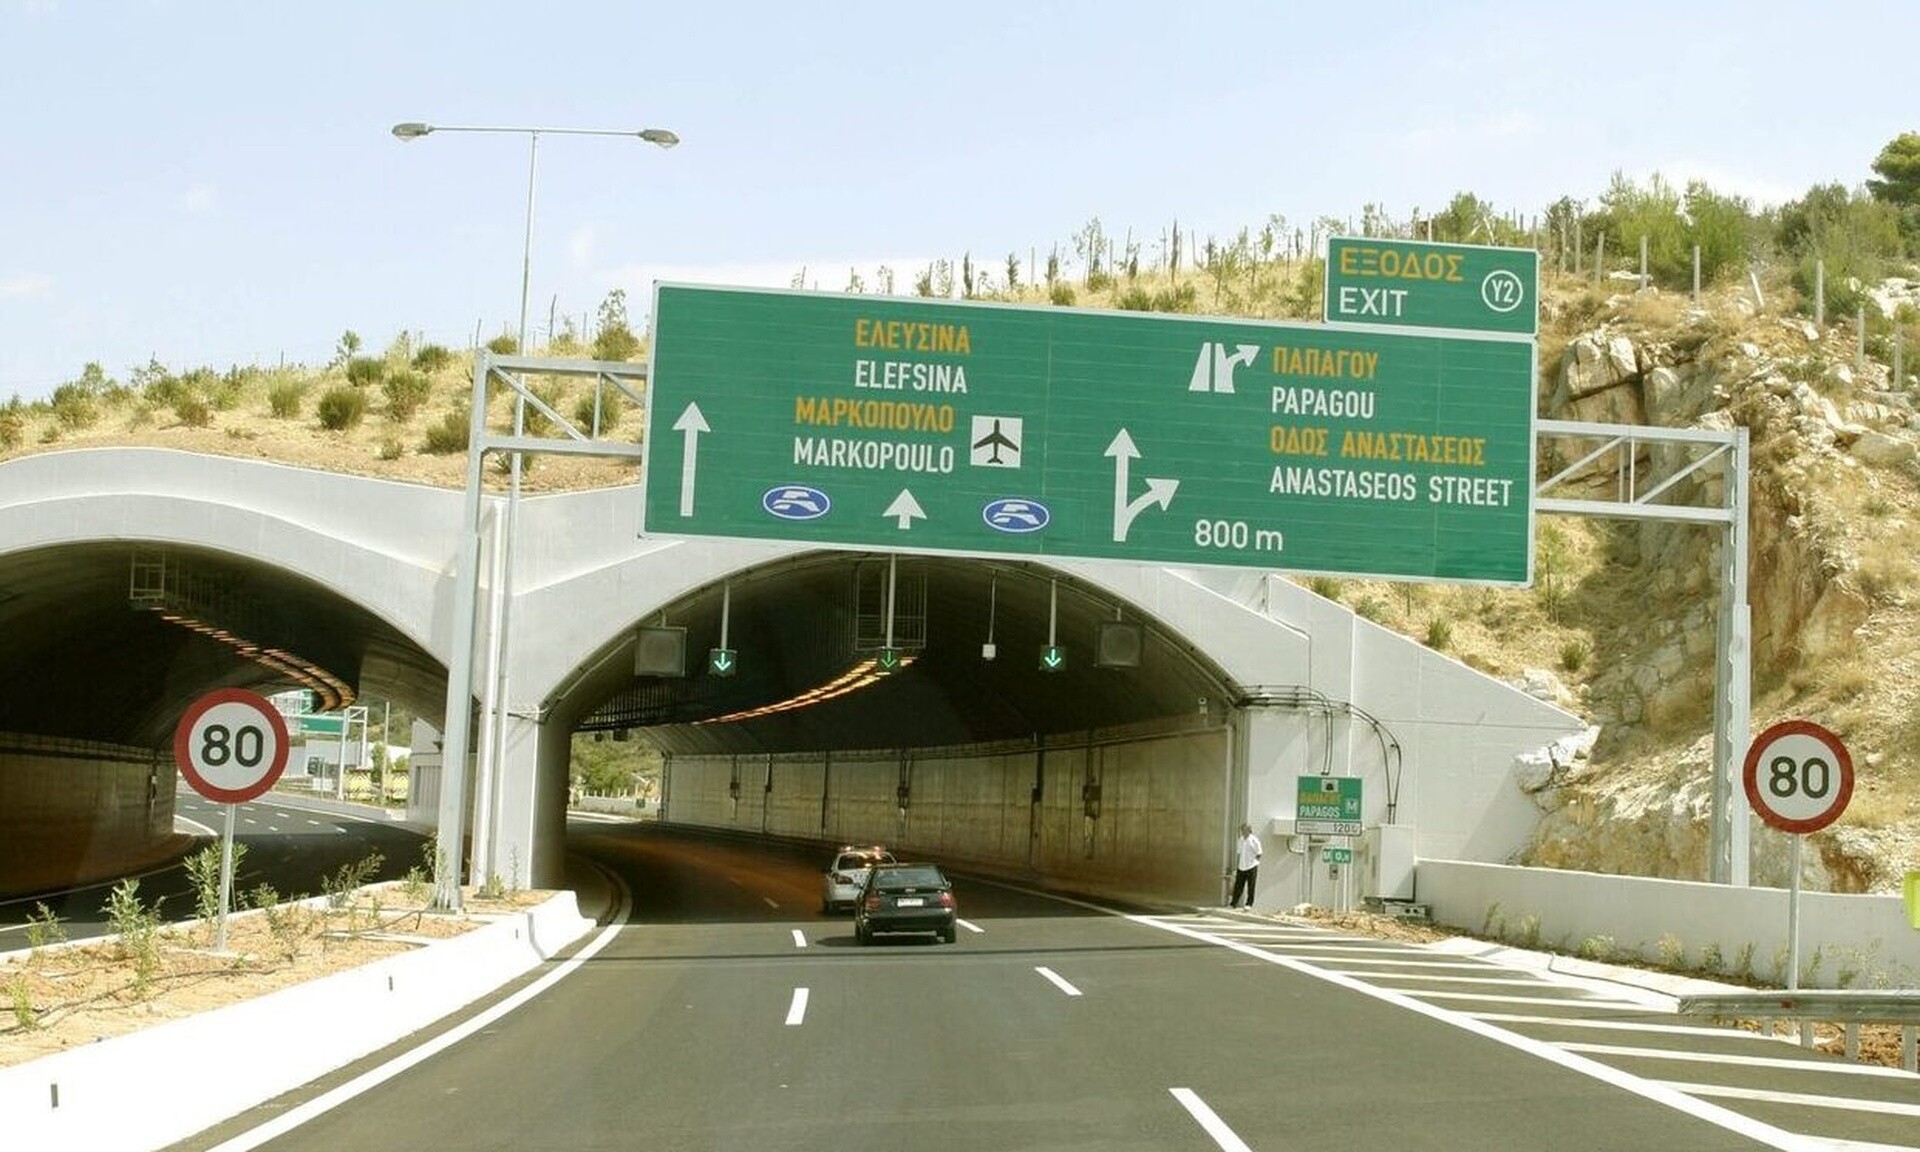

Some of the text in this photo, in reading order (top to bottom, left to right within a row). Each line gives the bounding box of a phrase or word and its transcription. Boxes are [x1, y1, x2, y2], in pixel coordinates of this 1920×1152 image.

[1339, 247, 1464, 282] ΕΞΟΔΟΣ
[1339, 287, 1408, 317] EXIT
[1492, 280, 1514, 304] Y2
[855, 319, 970, 355] ΕΛΕΥΣΙΝΑ
[855, 359, 967, 393] ELEFSINA
[1272, 346, 1378, 379] ΠΑΠΑΓΟΥ
[795, 396, 954, 433] ΜΑΡΚΟΠΟΥΛΟ
[1271, 387, 1375, 419] PAPAGOU
[794, 437, 954, 473] MARKOPOULO
[1270, 426, 1486, 466] ΟΔΟΣ ΑΝΑΣΤΑΣΕΩΣ
[1270, 466, 1513, 507] ANASTASEOS STREET
[1195, 520, 1284, 551] 800 m
[201, 724, 264, 767] 80
[1769, 756, 1830, 799] 80
